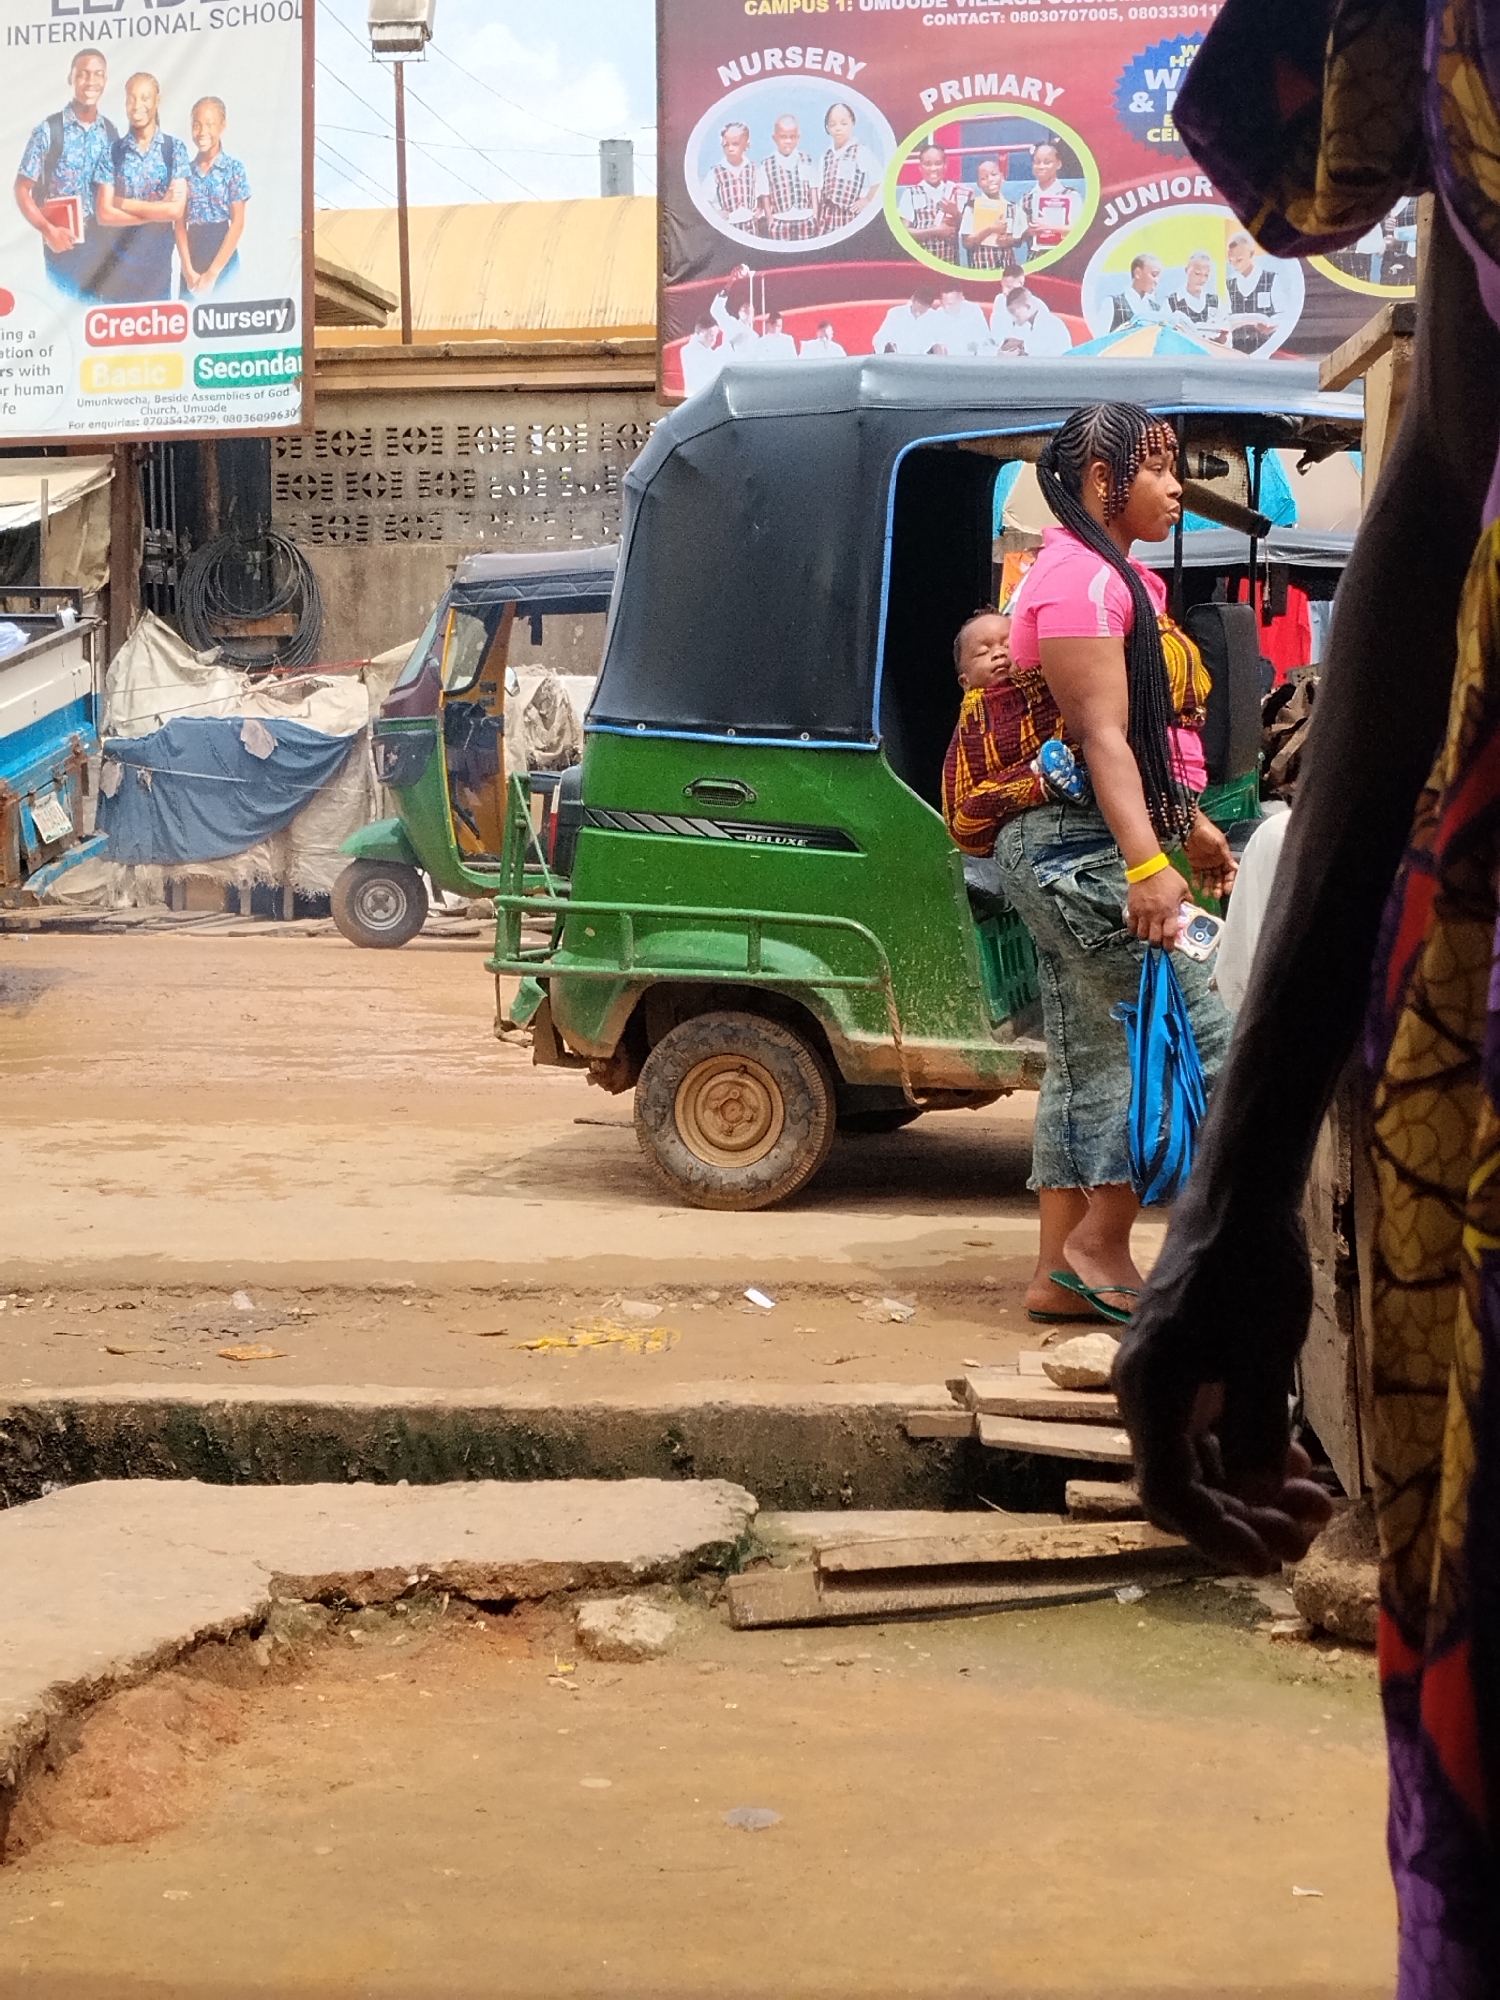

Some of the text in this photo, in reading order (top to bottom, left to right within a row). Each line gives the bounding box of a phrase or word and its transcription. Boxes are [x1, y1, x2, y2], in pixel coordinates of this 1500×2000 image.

[744, 0, 830, 16] CAMPUS
[922, 12, 1006, 26] CONTACT:
[1009, 8, 1124, 23] 08030707005,
[7, 12, 201, 46] INTERNATIONAL
[716, 46, 867, 87] NURSERY
[919, 73, 1065, 112] PRIMARY
[1103, 175, 1213, 226] JUNIOR
[88, 308, 185, 340] Creche
[197, 307, 288, 332] Nursery
[28, 330, 36, 340] a
[39, 345, 54, 358] of
[18, 364, 51, 377] with
[92, 357, 167, 387] Basic
[14, 384, 64, 397] human
[154, 393, 189, 404] Beside
[191, 391, 251, 402] Assemblies
[253, 390, 266, 400] of
[268, 388, 290, 398] God
[68, 421, 85, 430] For
[745, 834, 809, 848] DELUXE
